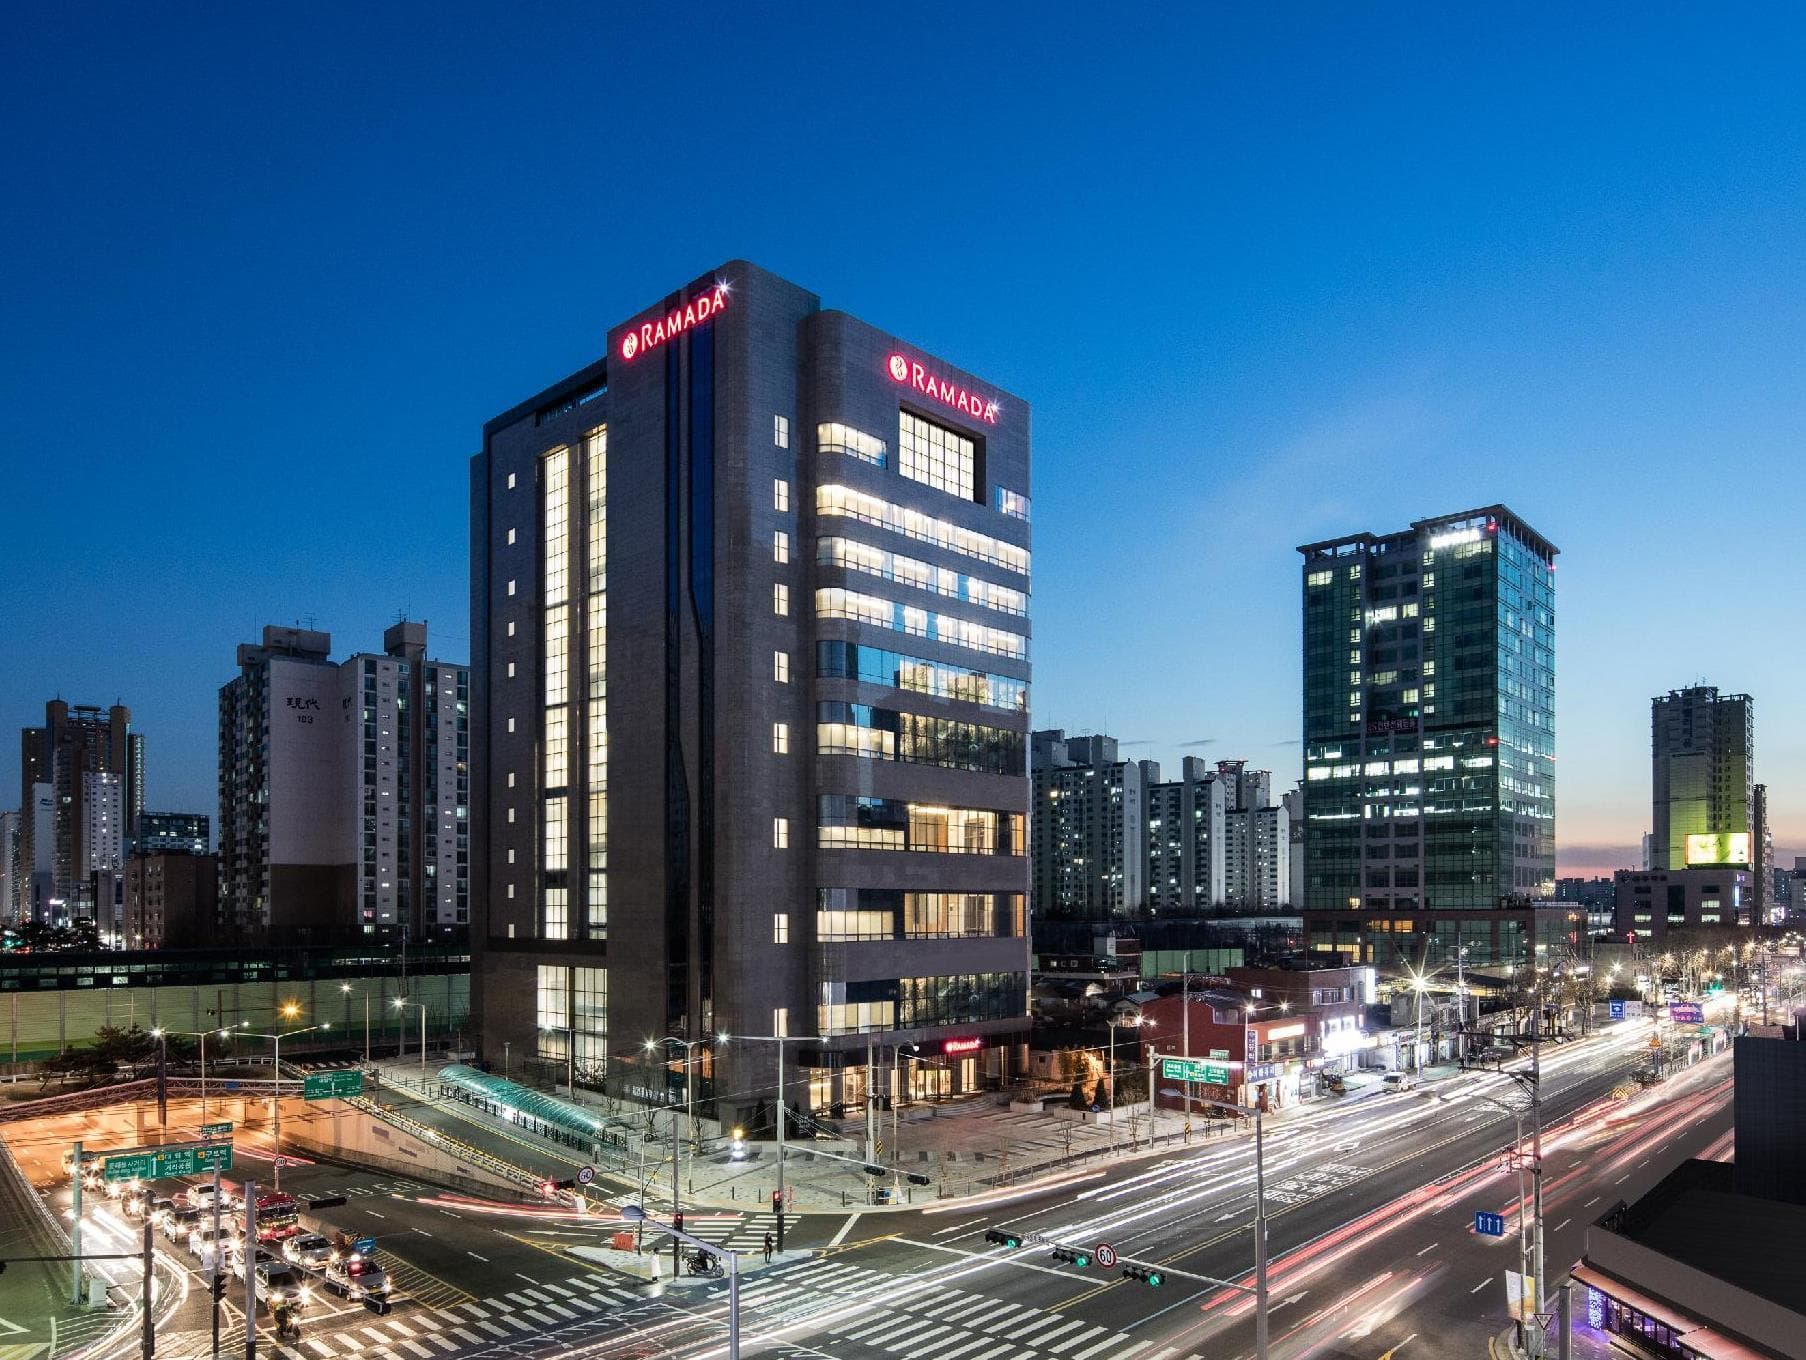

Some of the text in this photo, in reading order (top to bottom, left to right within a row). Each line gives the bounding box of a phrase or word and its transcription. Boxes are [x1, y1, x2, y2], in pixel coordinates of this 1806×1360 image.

[641, 288, 725, 352] RAMADA
[912, 362, 996, 424] RAMADA
[286, 697, 320, 710] 現代
[298, 715, 313, 724] 103
[1100, 1249, 1112, 1263] 60
